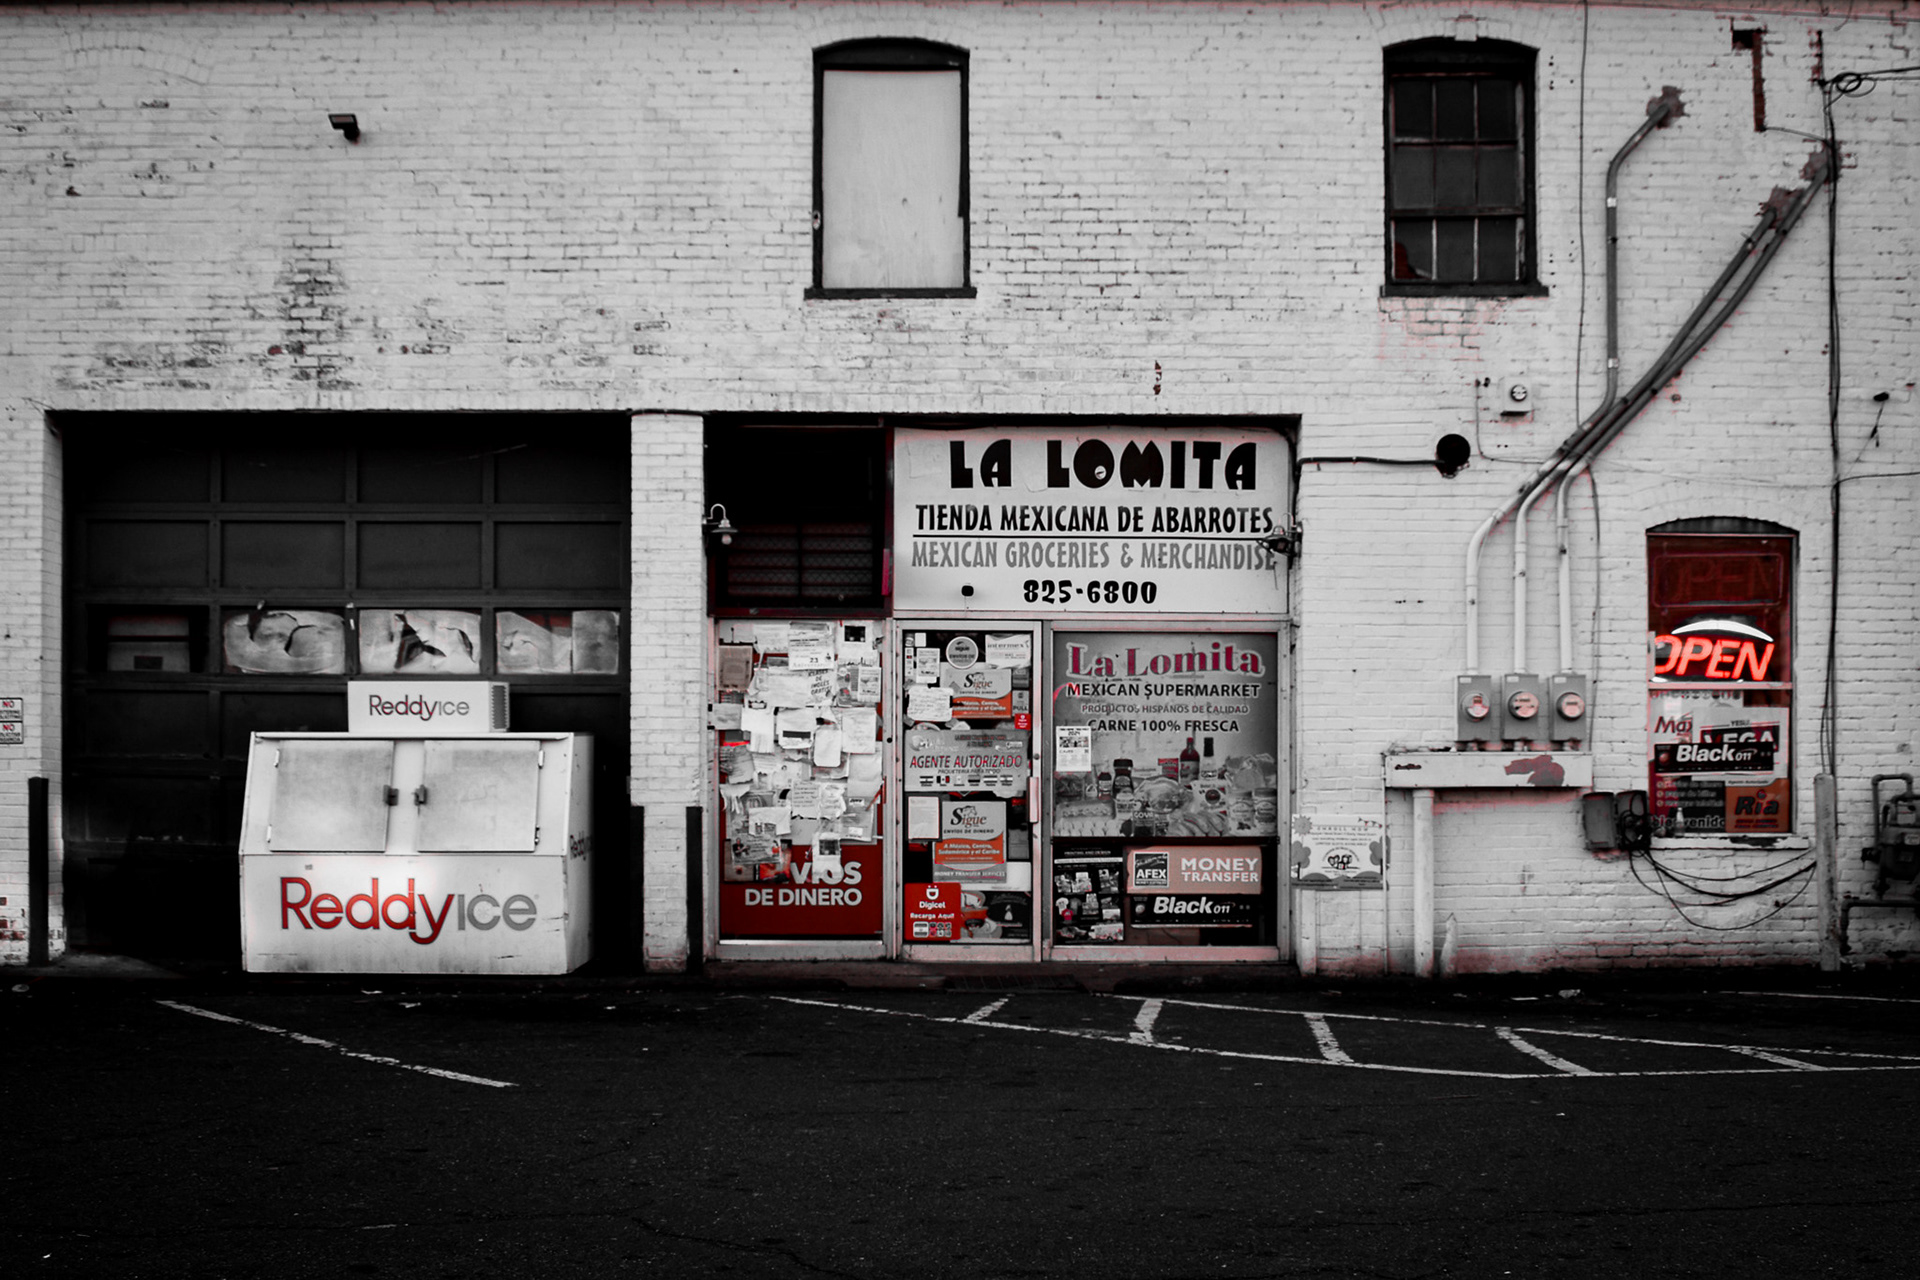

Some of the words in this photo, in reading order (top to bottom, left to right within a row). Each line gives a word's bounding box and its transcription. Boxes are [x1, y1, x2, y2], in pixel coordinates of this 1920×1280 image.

[949, 439, 1012, 489] LA
[1047, 438, 1257, 490] LOMITA
[915, 504, 993, 532] TIENDA
[1000, 504, 1108, 532] MEXICANA
[1117, 505, 1145, 532] DE
[1151, 505, 1273, 534] ABARROTES
[911, 541, 998, 569] MEXICAN
[1004, 541, 1110, 569] GROCERIES
[1120, 542, 1134, 569] &
[1141, 541, 1276, 571] MERCHANDISE
[1022, 579, 1158, 604] 825-6800
[1067, 644, 1117, 678] La
[1125, 641, 1265, 677] Lomita
[1653, 634, 1775, 681] OPEN
[1067, 683, 1139, 697] MEXICAN
[1144, 683, 1260, 698] SUPERMARKET
[1082, 704, 1141, 714] PRODUCTOS
[1142, 704, 1189, 714] HISPANOS
[1191, 704, 1205, 714] DE
[1206, 704, 1248, 714] CALIDAD
[1088, 719, 1136, 732] CARNE
[1141, 719, 1181, 732] 100%
[1184, 719, 1239, 732] FRESCA
[910, 755, 951, 768] AGENTE
[953, 755, 1023, 768] AUTORIZADO
[1676, 744, 1736, 762] Black
[1734, 789, 1779, 815] Ria
[950, 807, 987, 828] Sigue
[1181, 857, 1259, 871] MONEY
[1136, 868, 1166, 879] AFEX
[1181, 871, 1259, 883] TRANSFER
[744, 888, 774, 906] DE
[778, 888, 862, 906] DINERO
[919, 901, 946, 910] Digicel
[1153, 896, 1213, 915] Black
